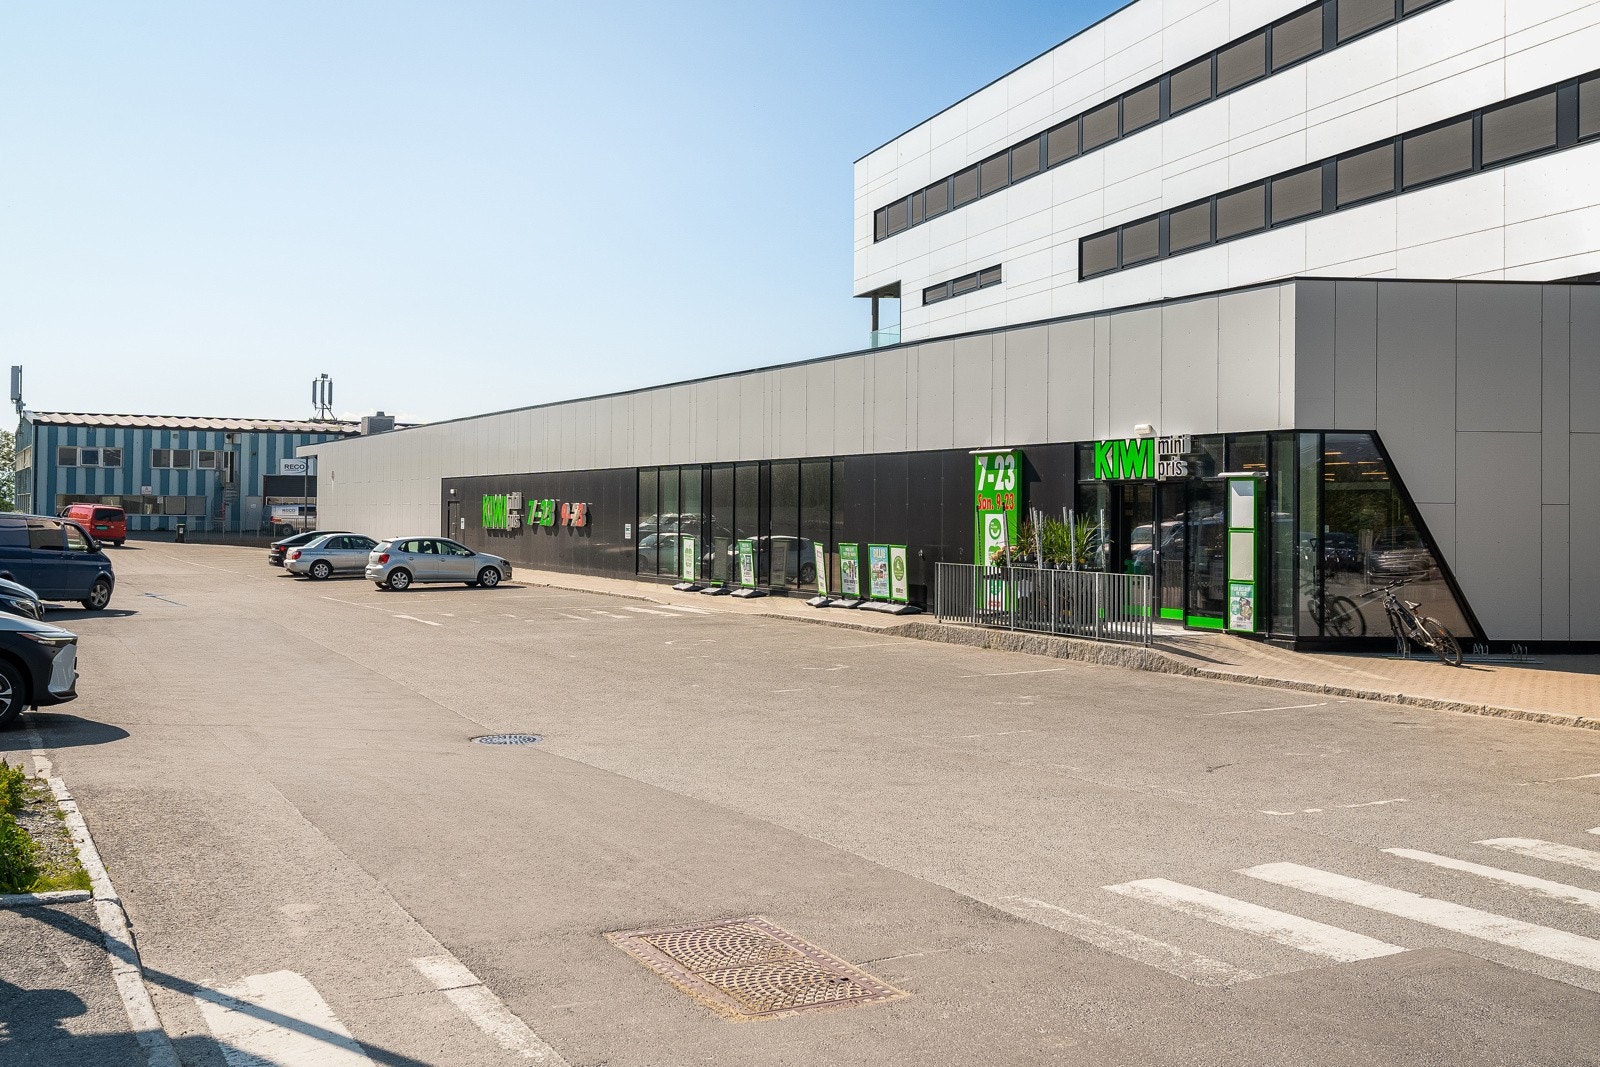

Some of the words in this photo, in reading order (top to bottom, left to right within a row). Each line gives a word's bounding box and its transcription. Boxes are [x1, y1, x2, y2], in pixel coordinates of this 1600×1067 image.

[1158, 434, 1186, 454] mini
[977, 454, 1015, 491] 7-23
[1094, 438, 1155, 480] KIWI
[1158, 456, 1183, 480] pris
[527, 499, 555, 527] 7-23
